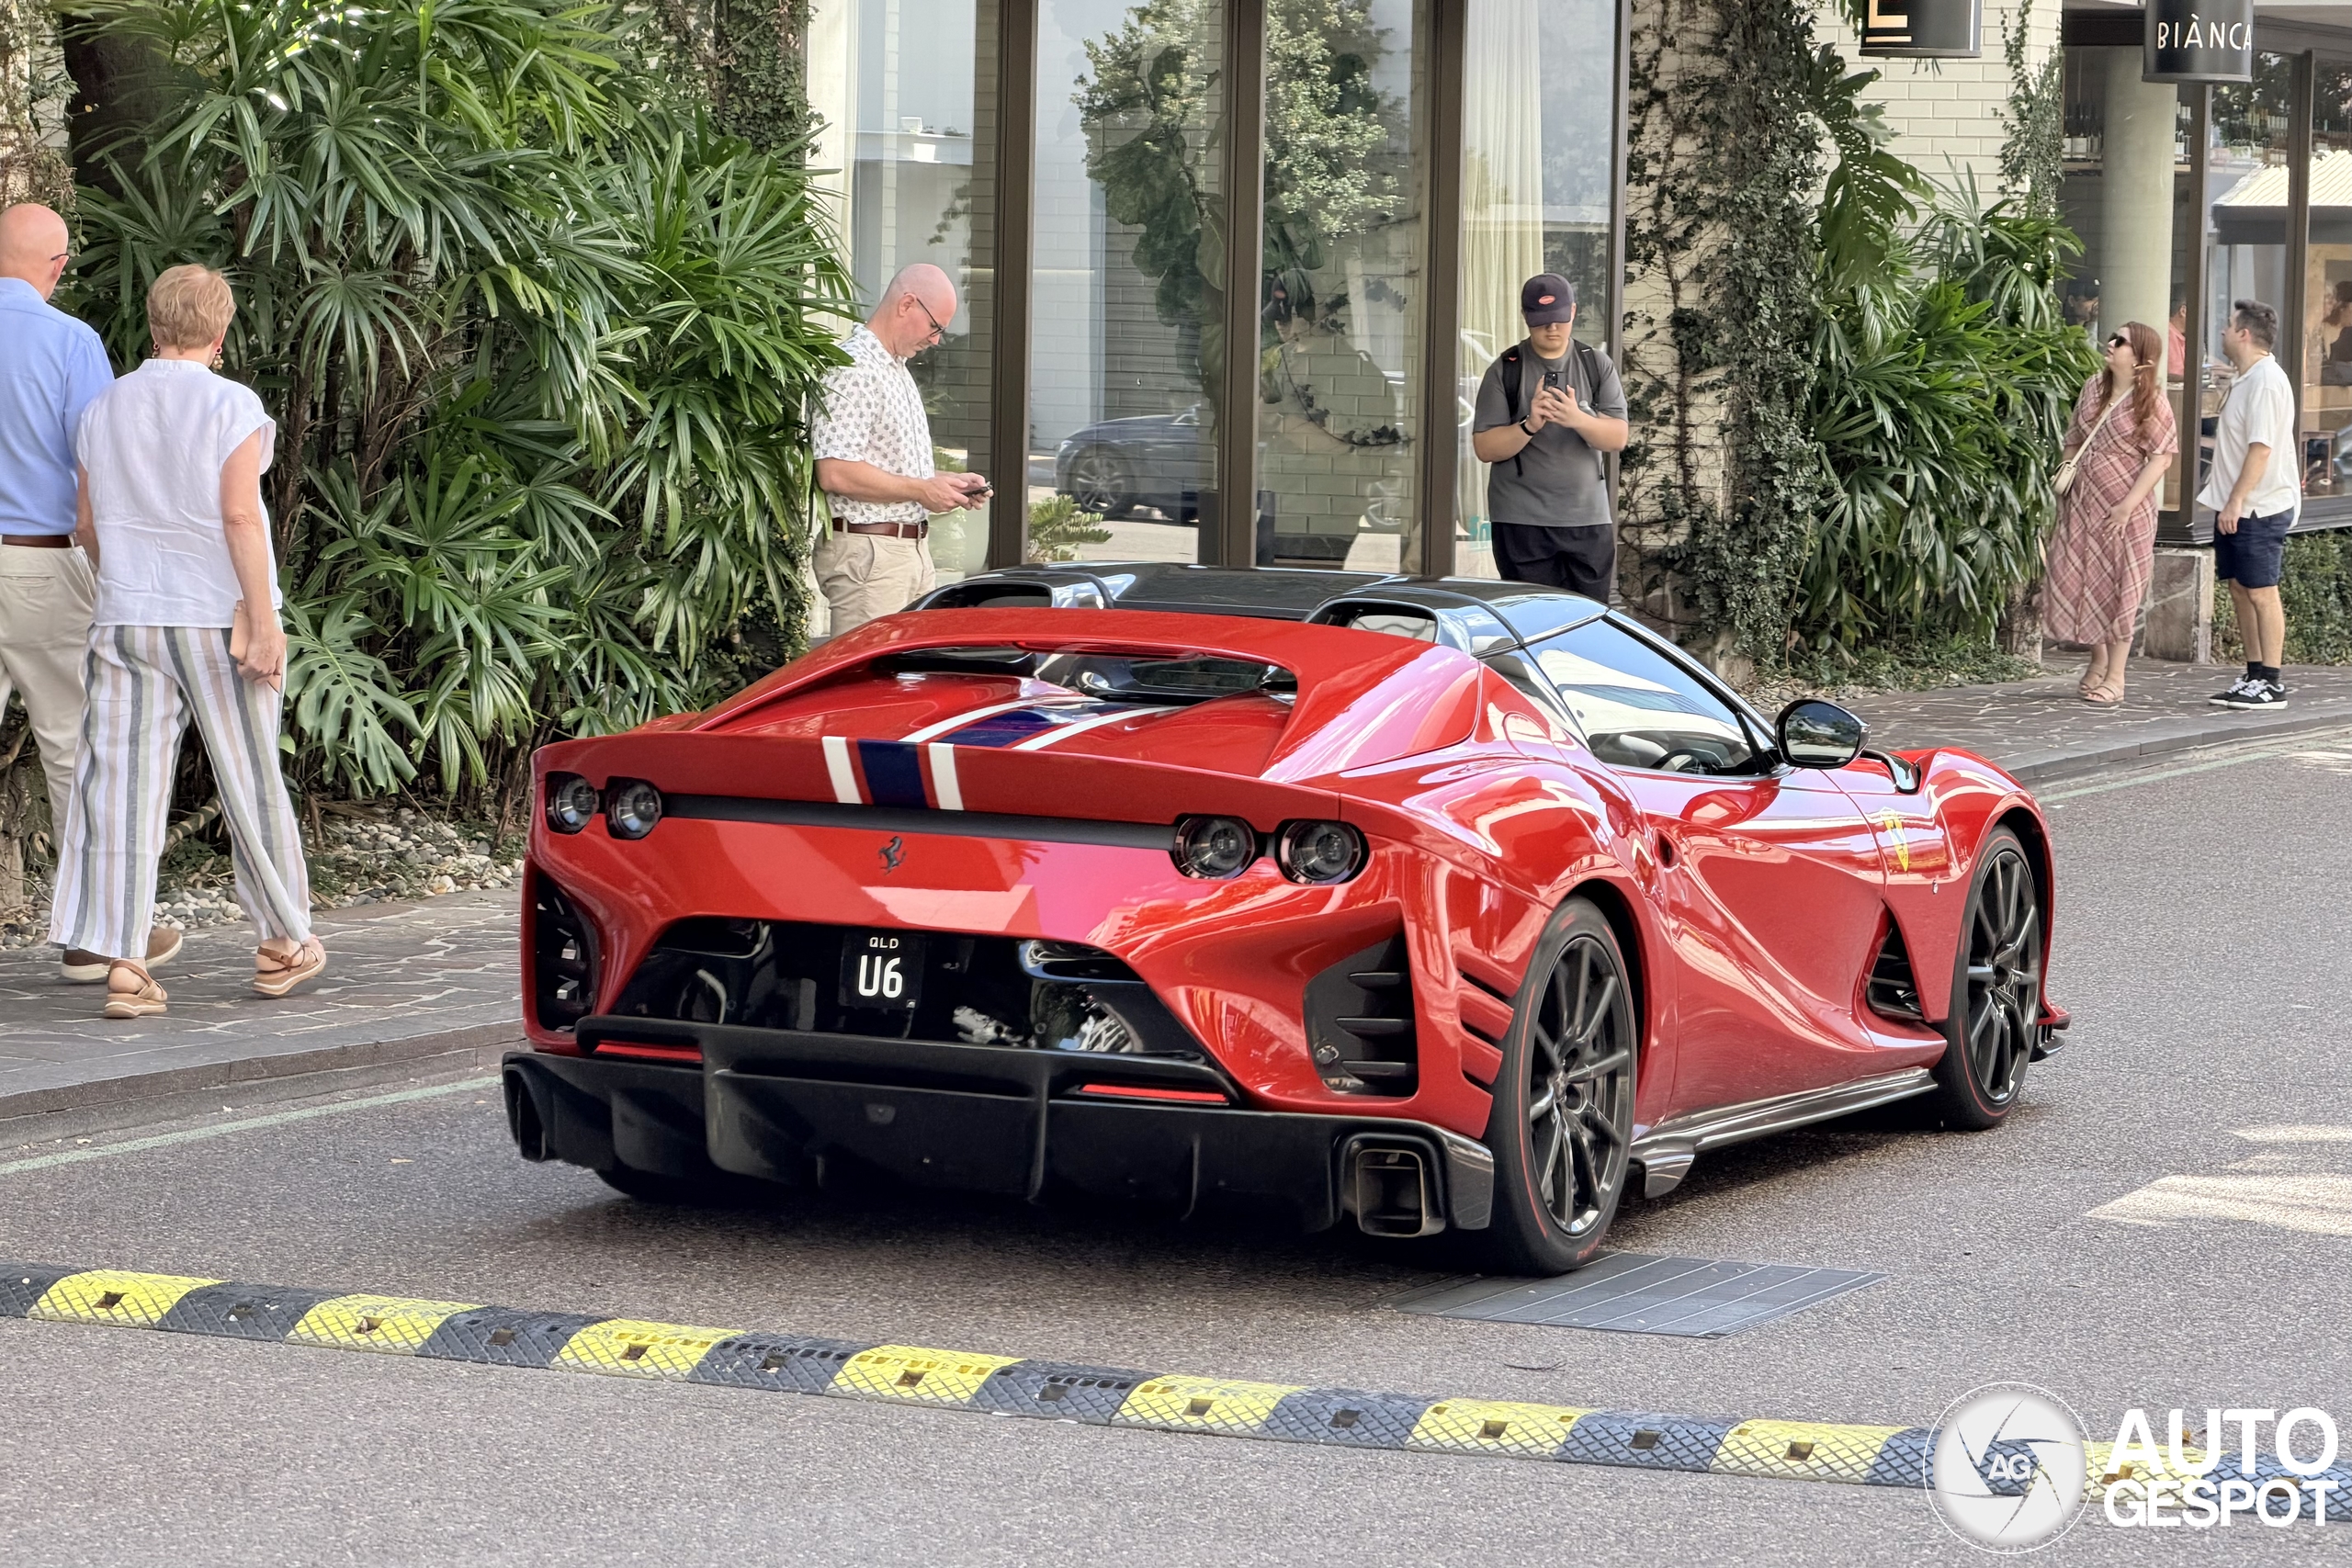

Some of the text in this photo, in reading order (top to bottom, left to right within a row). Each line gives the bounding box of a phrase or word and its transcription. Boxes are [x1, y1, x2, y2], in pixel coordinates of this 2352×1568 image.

[2157, 13, 2252, 51] BIÀNCA
[869, 937, 899, 949] QLD
[858, 954, 903, 998] U6
